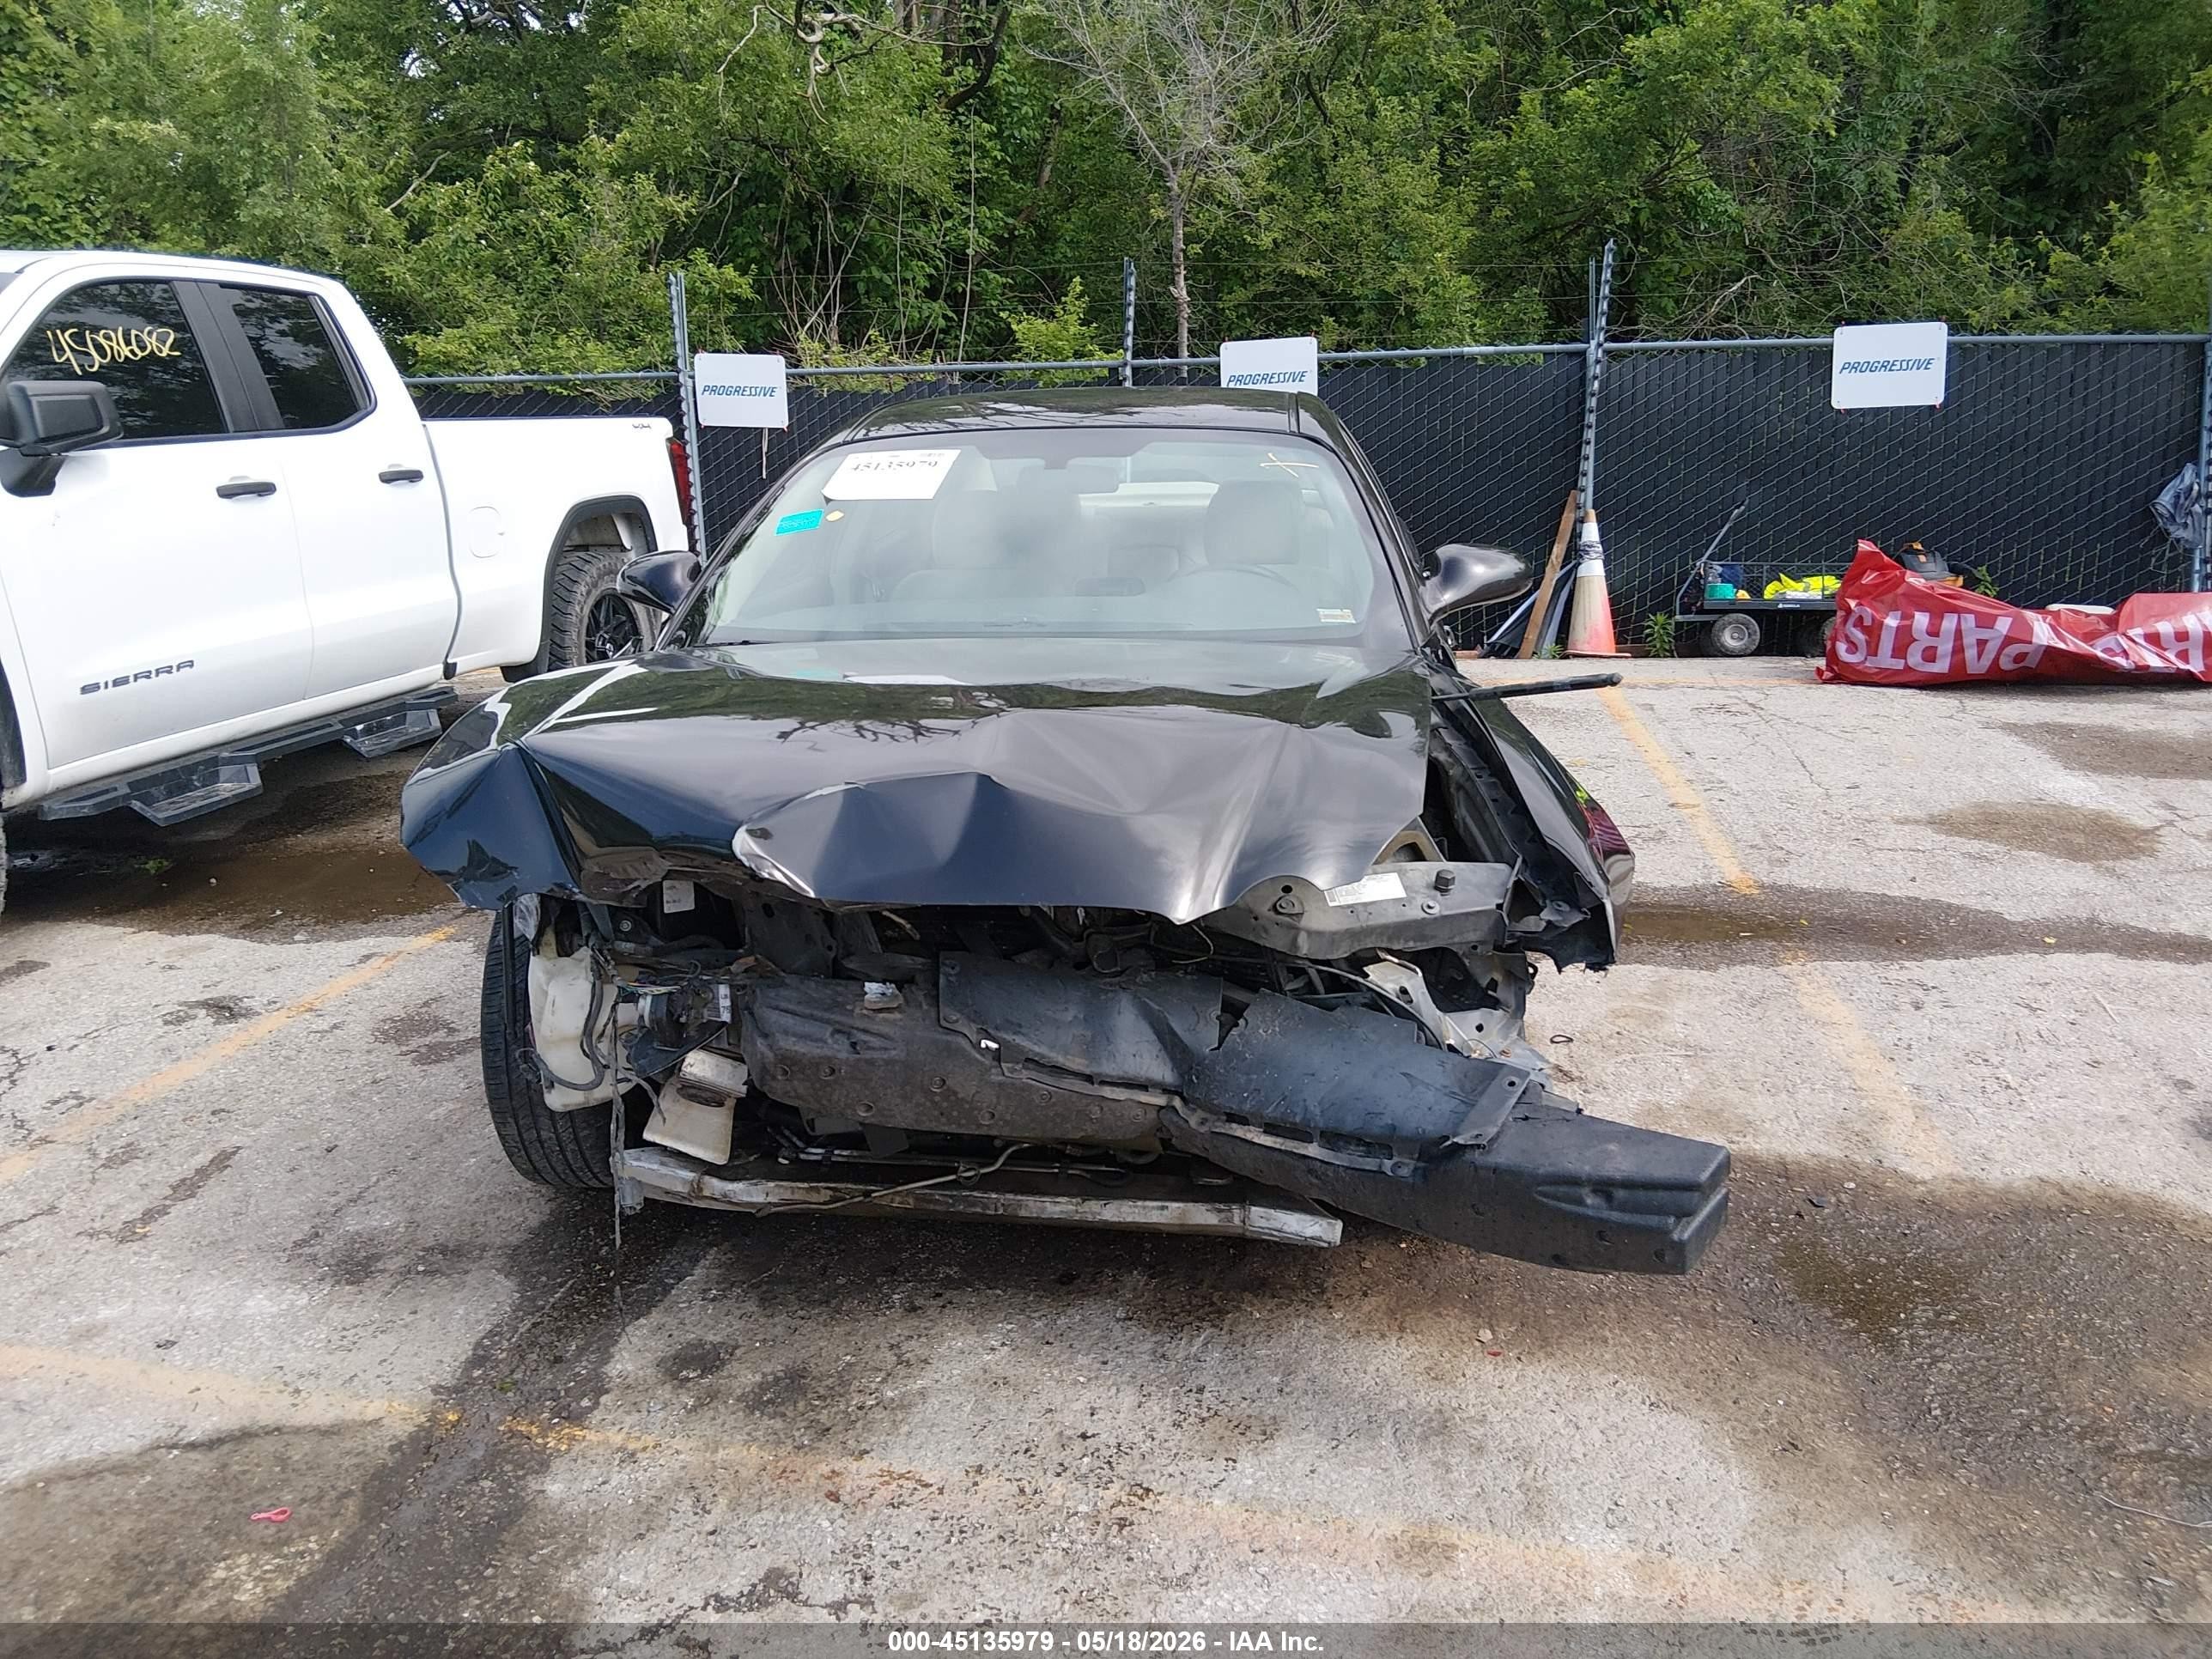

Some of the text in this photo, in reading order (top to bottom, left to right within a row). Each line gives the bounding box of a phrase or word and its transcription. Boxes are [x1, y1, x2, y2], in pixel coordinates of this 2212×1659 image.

[1838, 357, 1936, 374] PROGRESSIVE
[1226, 370, 1309, 387] PROGRESSIVE
[702, 385, 778, 398] PROGRESSIVE
[1836, 605, 2051, 674] PARTS
[80, 659, 195, 695] SIERRA
